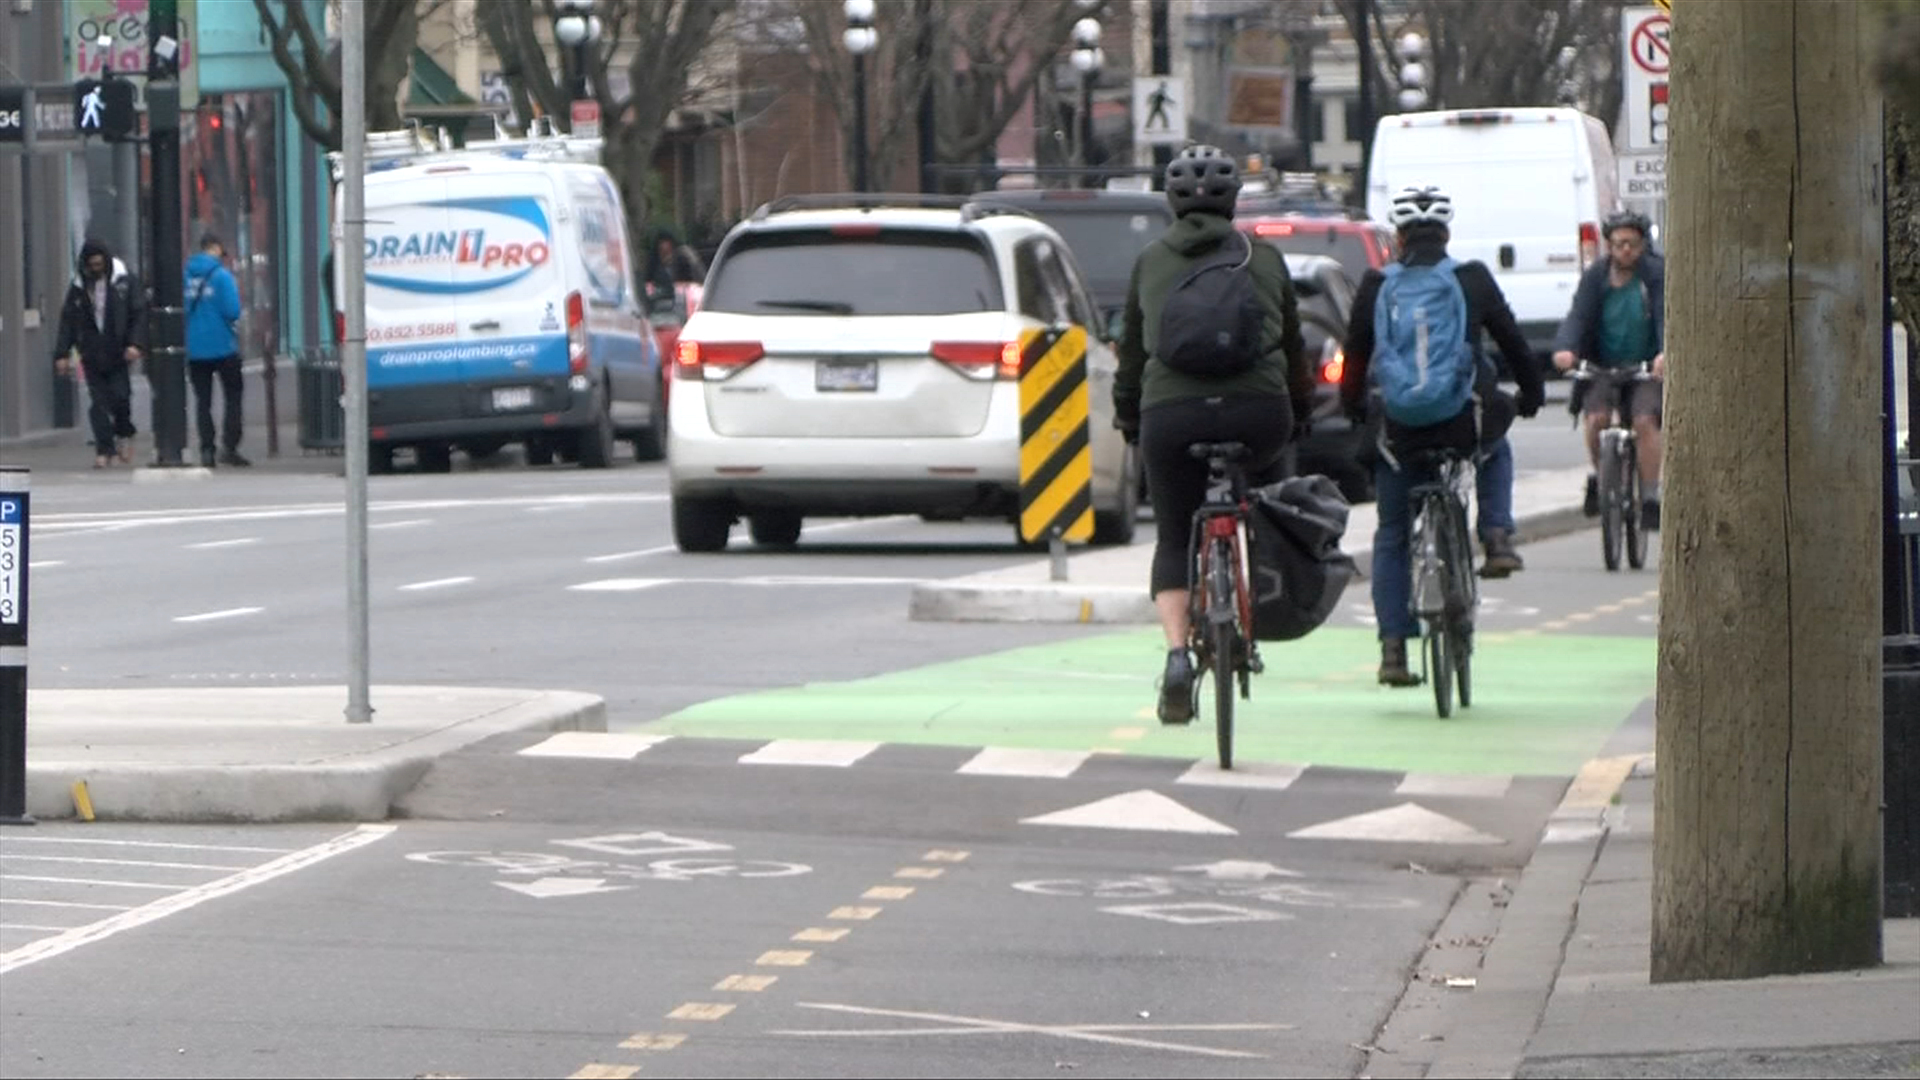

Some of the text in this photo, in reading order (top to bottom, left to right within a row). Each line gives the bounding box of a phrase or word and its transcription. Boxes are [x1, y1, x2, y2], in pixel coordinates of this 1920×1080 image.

[1635, 160, 1666, 174] EXC
[365, 230, 457, 260] DRAIN
[482, 241, 550, 269] PRO
[379, 342, 536, 369] drainproplumbing.ca
[1, 501, 16, 520] P
[1, 528, 14, 618] 5313
